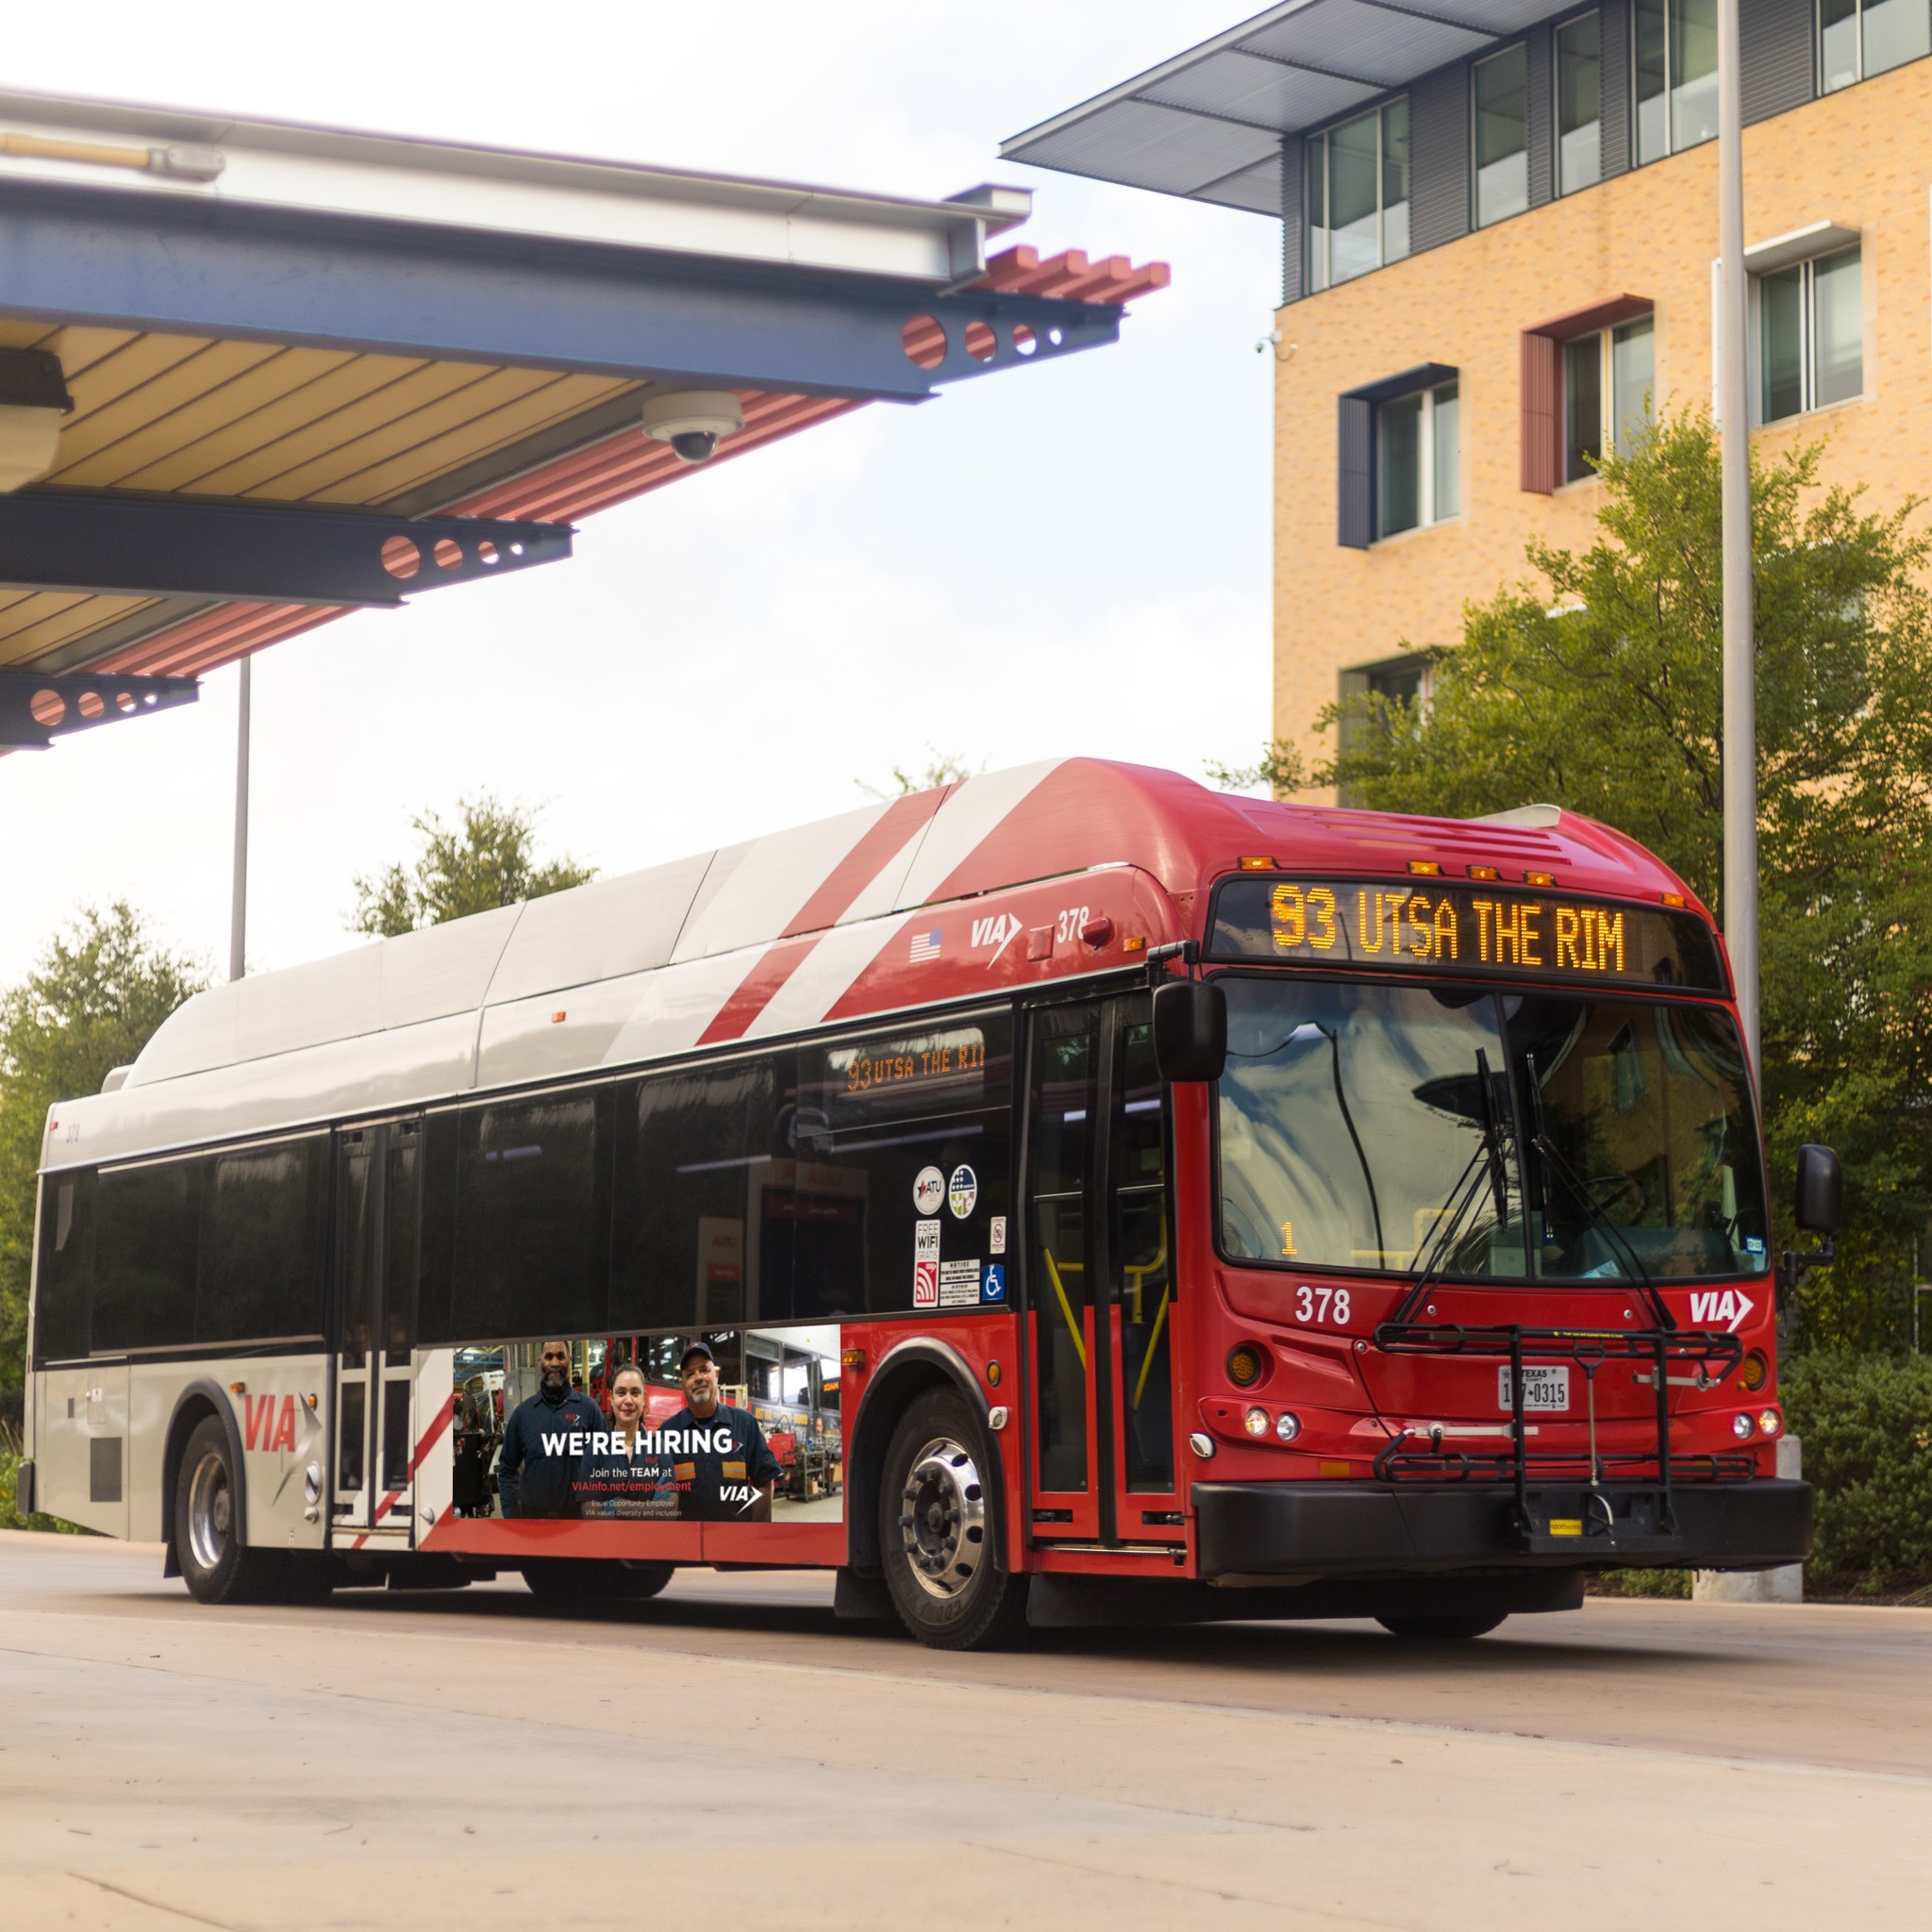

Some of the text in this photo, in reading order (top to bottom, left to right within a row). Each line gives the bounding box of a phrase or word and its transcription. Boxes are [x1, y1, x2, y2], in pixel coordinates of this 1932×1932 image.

[971, 914, 1007, 948] VIA
[1057, 906, 1090, 943] 378
[1273, 884, 1625, 972] 93 UTSA THE RIM
[847, 1058, 872, 1091] 93
[874, 1056, 914, 1083] UTSA
[922, 1048, 951, 1075] THE
[926, 1179, 941, 1193] ATU
[917, 1236, 939, 1249] WIFI
[918, 1223, 940, 1236] FREE
[1280, 1222, 1298, 1255] 1
[917, 1250, 938, 1260] GRATIS
[1295, 1286, 1351, 1324] 378
[1690, 1291, 1736, 1323] VIA
[244, 1394, 295, 1453] VIA
[635, 1428, 733, 1455] HIRING
[572, 1480, 691, 1492] VIAinfo.net/employment
[590, 1468, 673, 1478] Join the TEAM at
[720, 1486, 749, 1502] VIA
